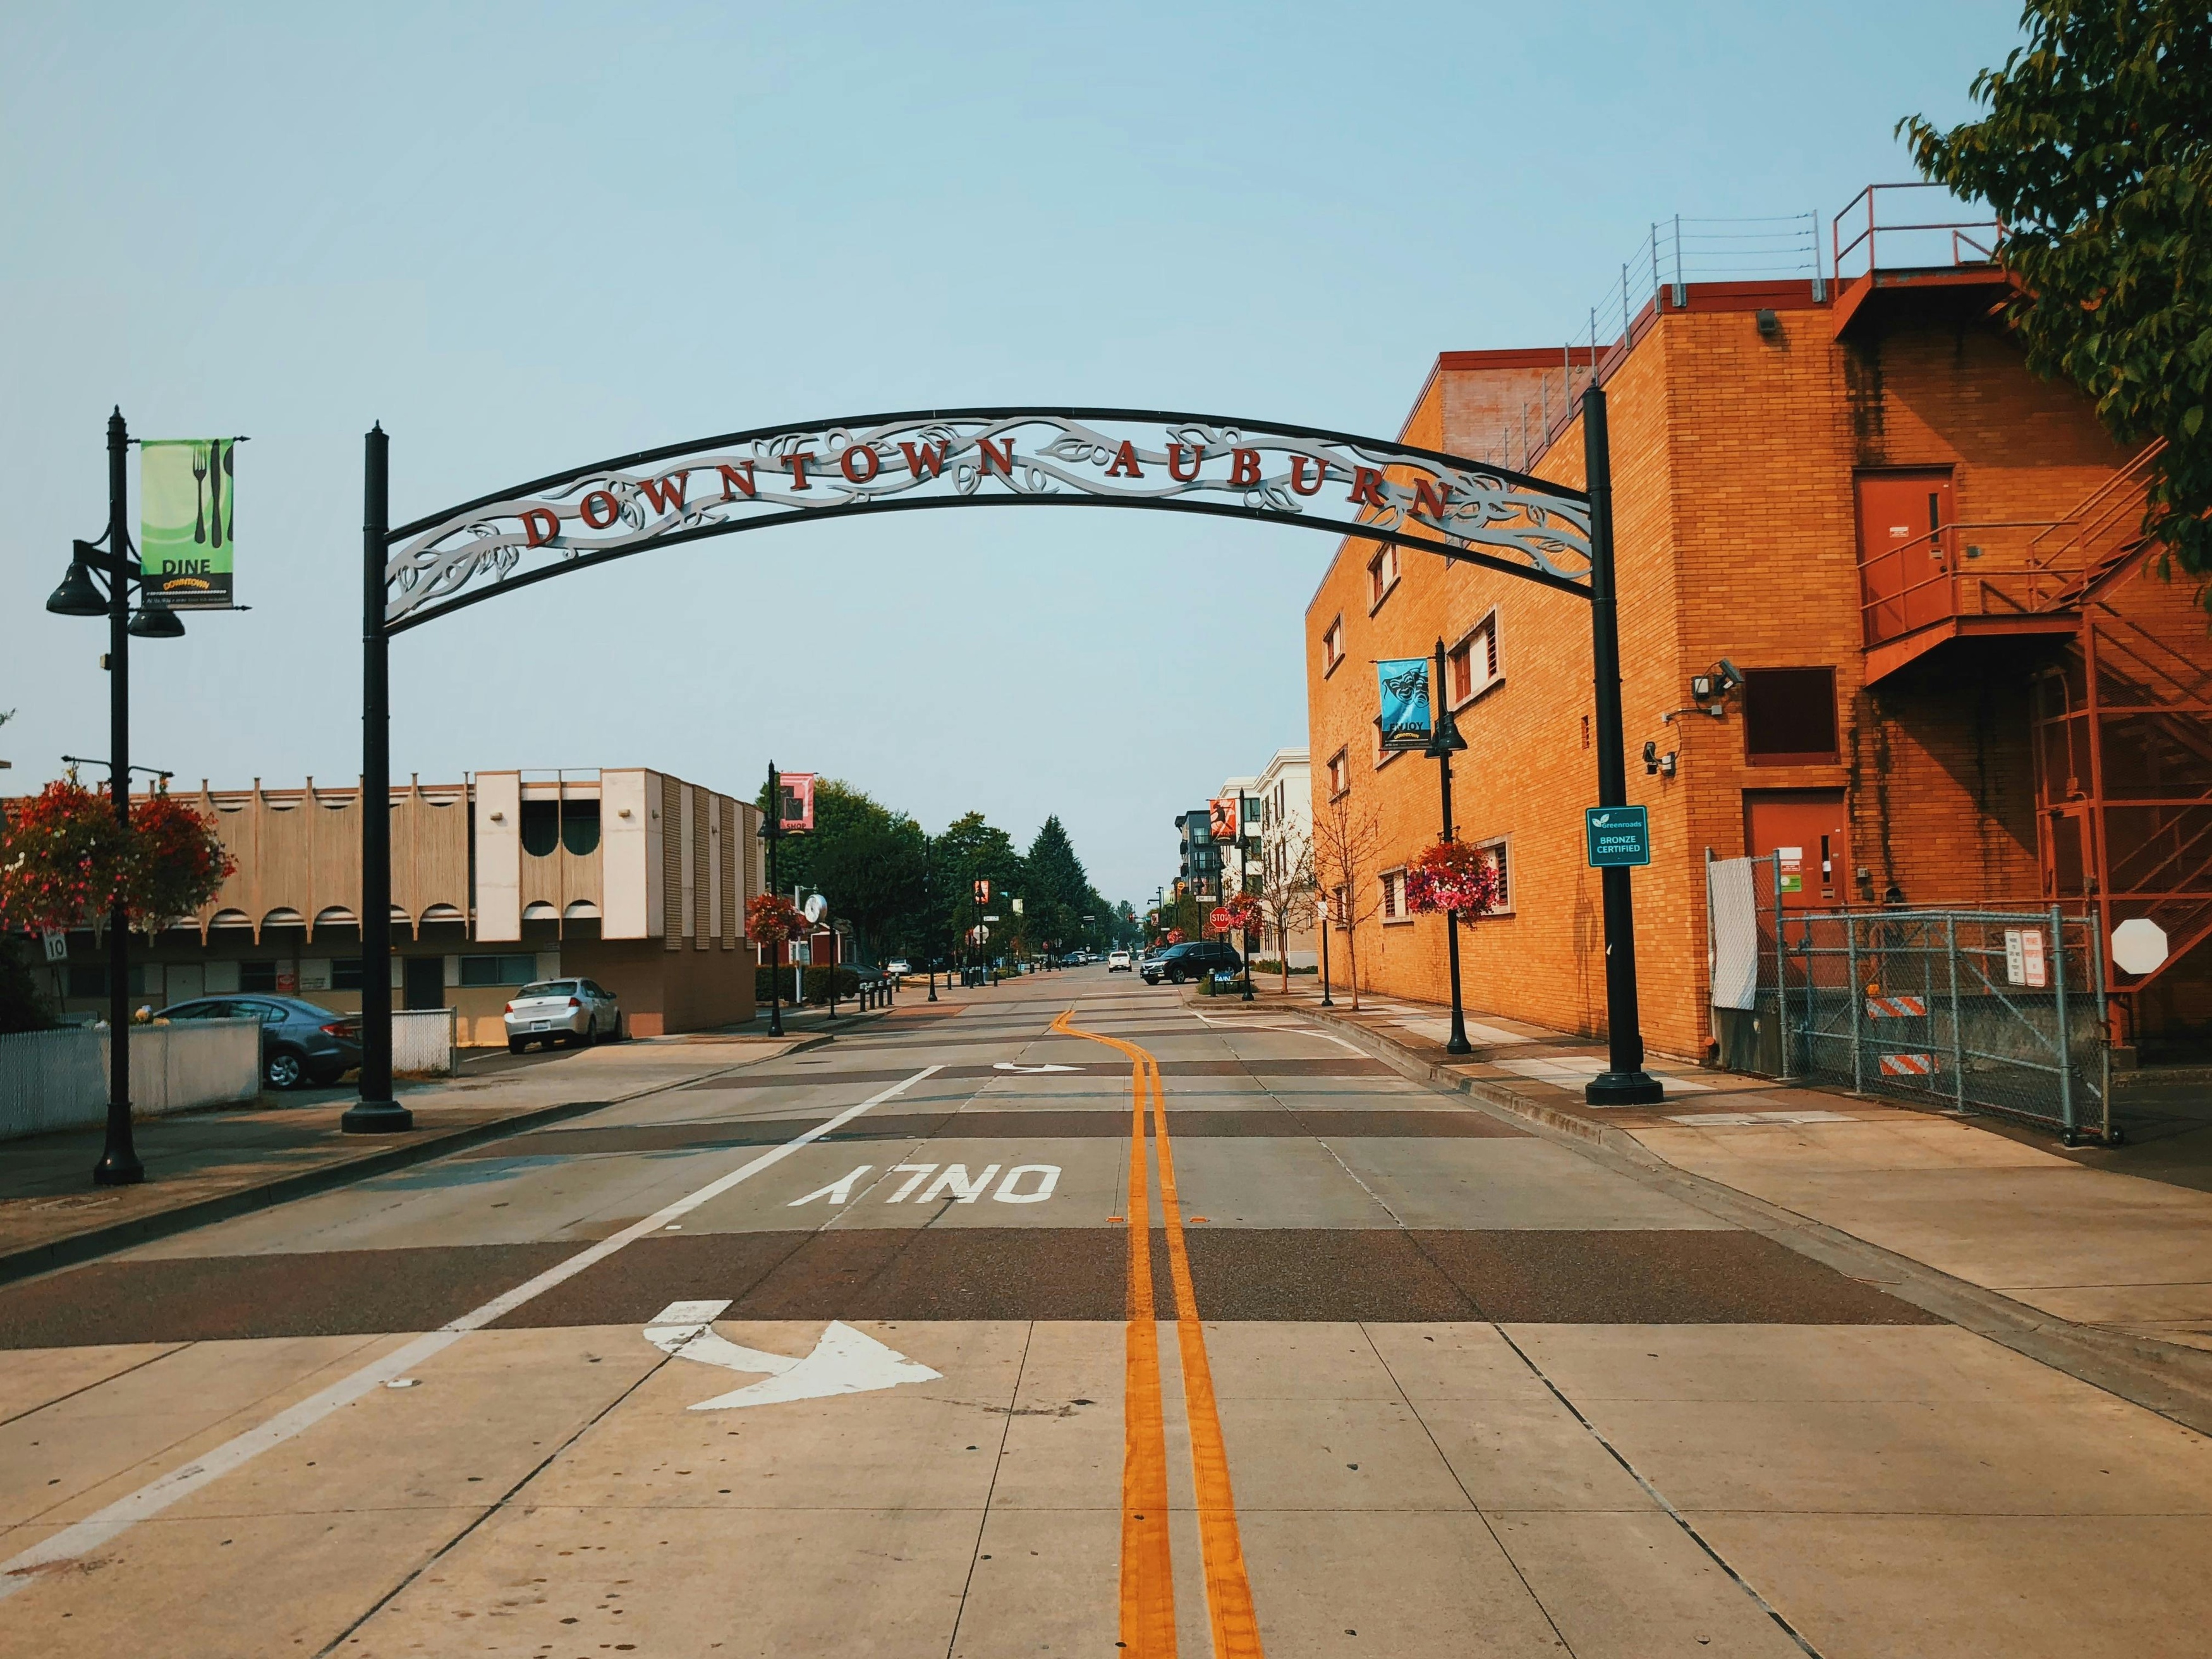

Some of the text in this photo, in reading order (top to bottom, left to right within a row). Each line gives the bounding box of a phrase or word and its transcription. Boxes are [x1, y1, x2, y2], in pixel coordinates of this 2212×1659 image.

[518, 437, 1454, 550] DOWNTOWN AUBURN
[162, 559, 210, 574] DINE
[163, 578, 210, 591] DOWNTOWN
[1390, 722, 1424, 731] ENJOY
[1600, 836, 1636, 844] BRONZE
[1596, 844, 1641, 854] CERTIFIED
[49, 939, 64, 957] 10
[786, 1163, 1062, 1206] ONLY
